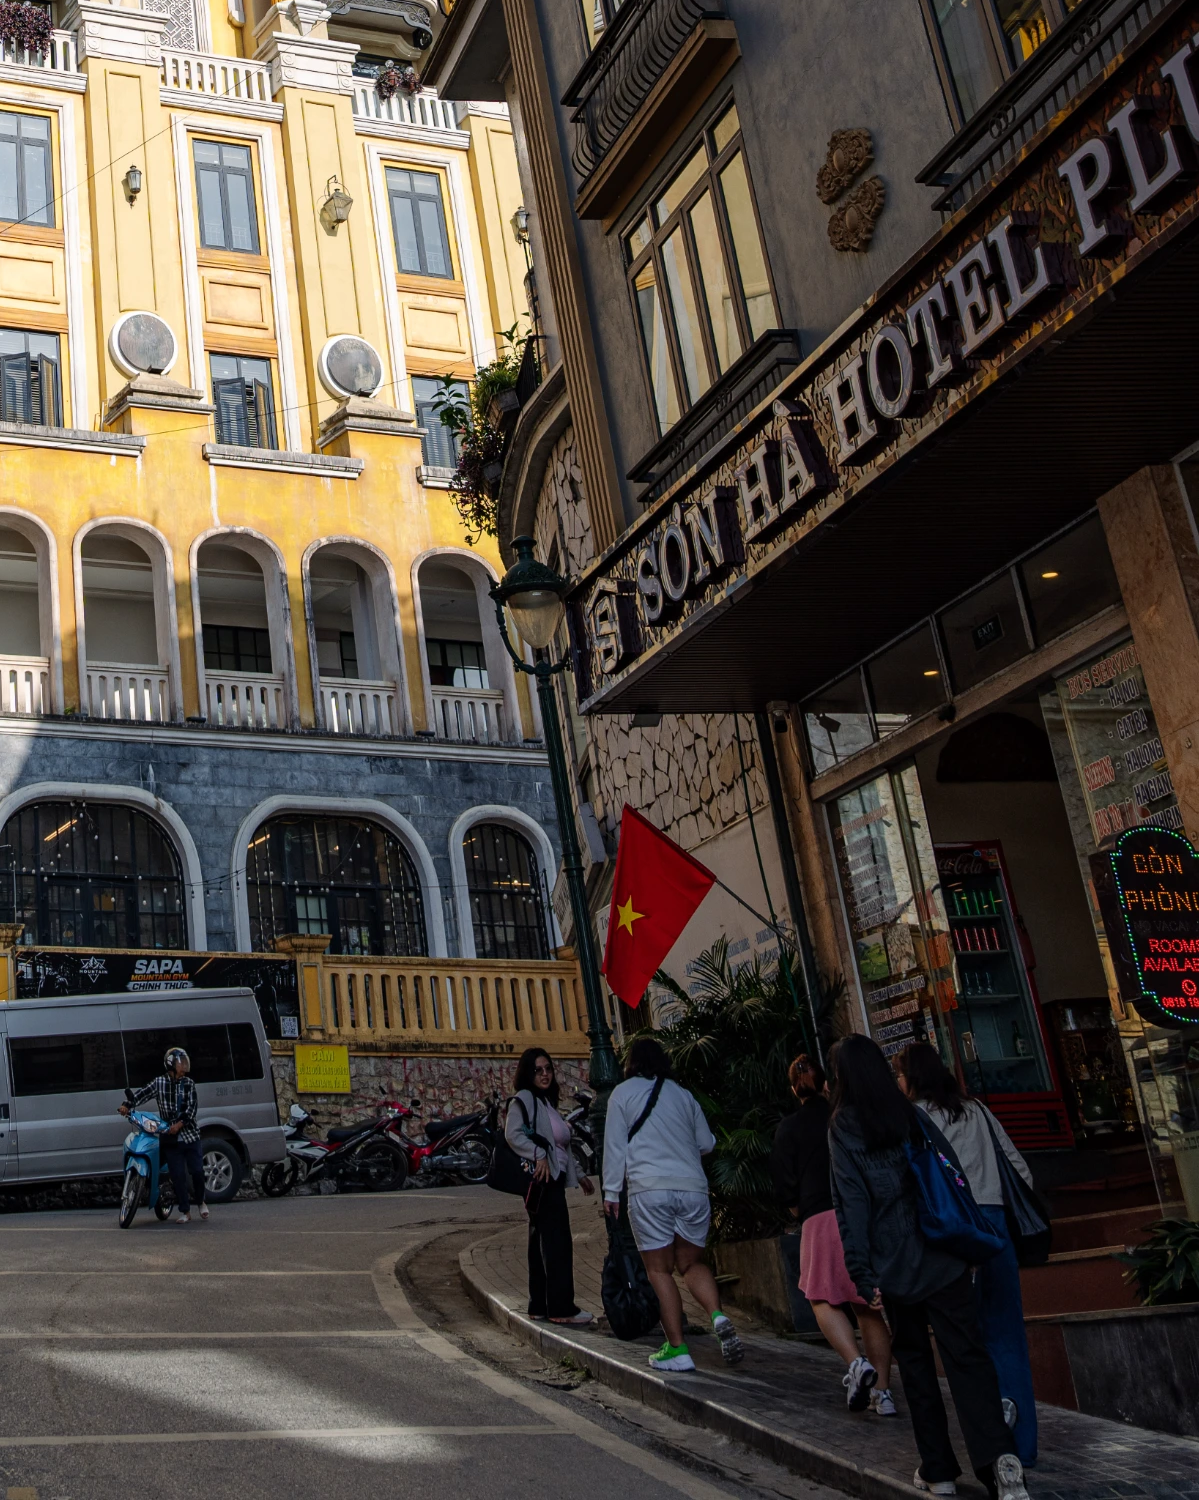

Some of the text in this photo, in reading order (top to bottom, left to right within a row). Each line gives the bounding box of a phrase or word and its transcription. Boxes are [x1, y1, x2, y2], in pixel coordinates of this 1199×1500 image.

[734, 399, 816, 544] HÀ
[822, 216, 1050, 466] HOTEL
[1066, 669, 1093, 700] BUS
[1108, 674, 1141, 710] HA NOI
[1115, 707, 1149, 742] CAT BA
[1124, 737, 1165, 775] HA LONG
[1133, 780, 1150, 807] HA
[130, 972, 190, 981] MOUNTAIN GYM
[134, 959, 184, 974] SAPA
[132, 980, 161, 990] CHÍNH
[310, 1046, 334, 1061] CẤM
